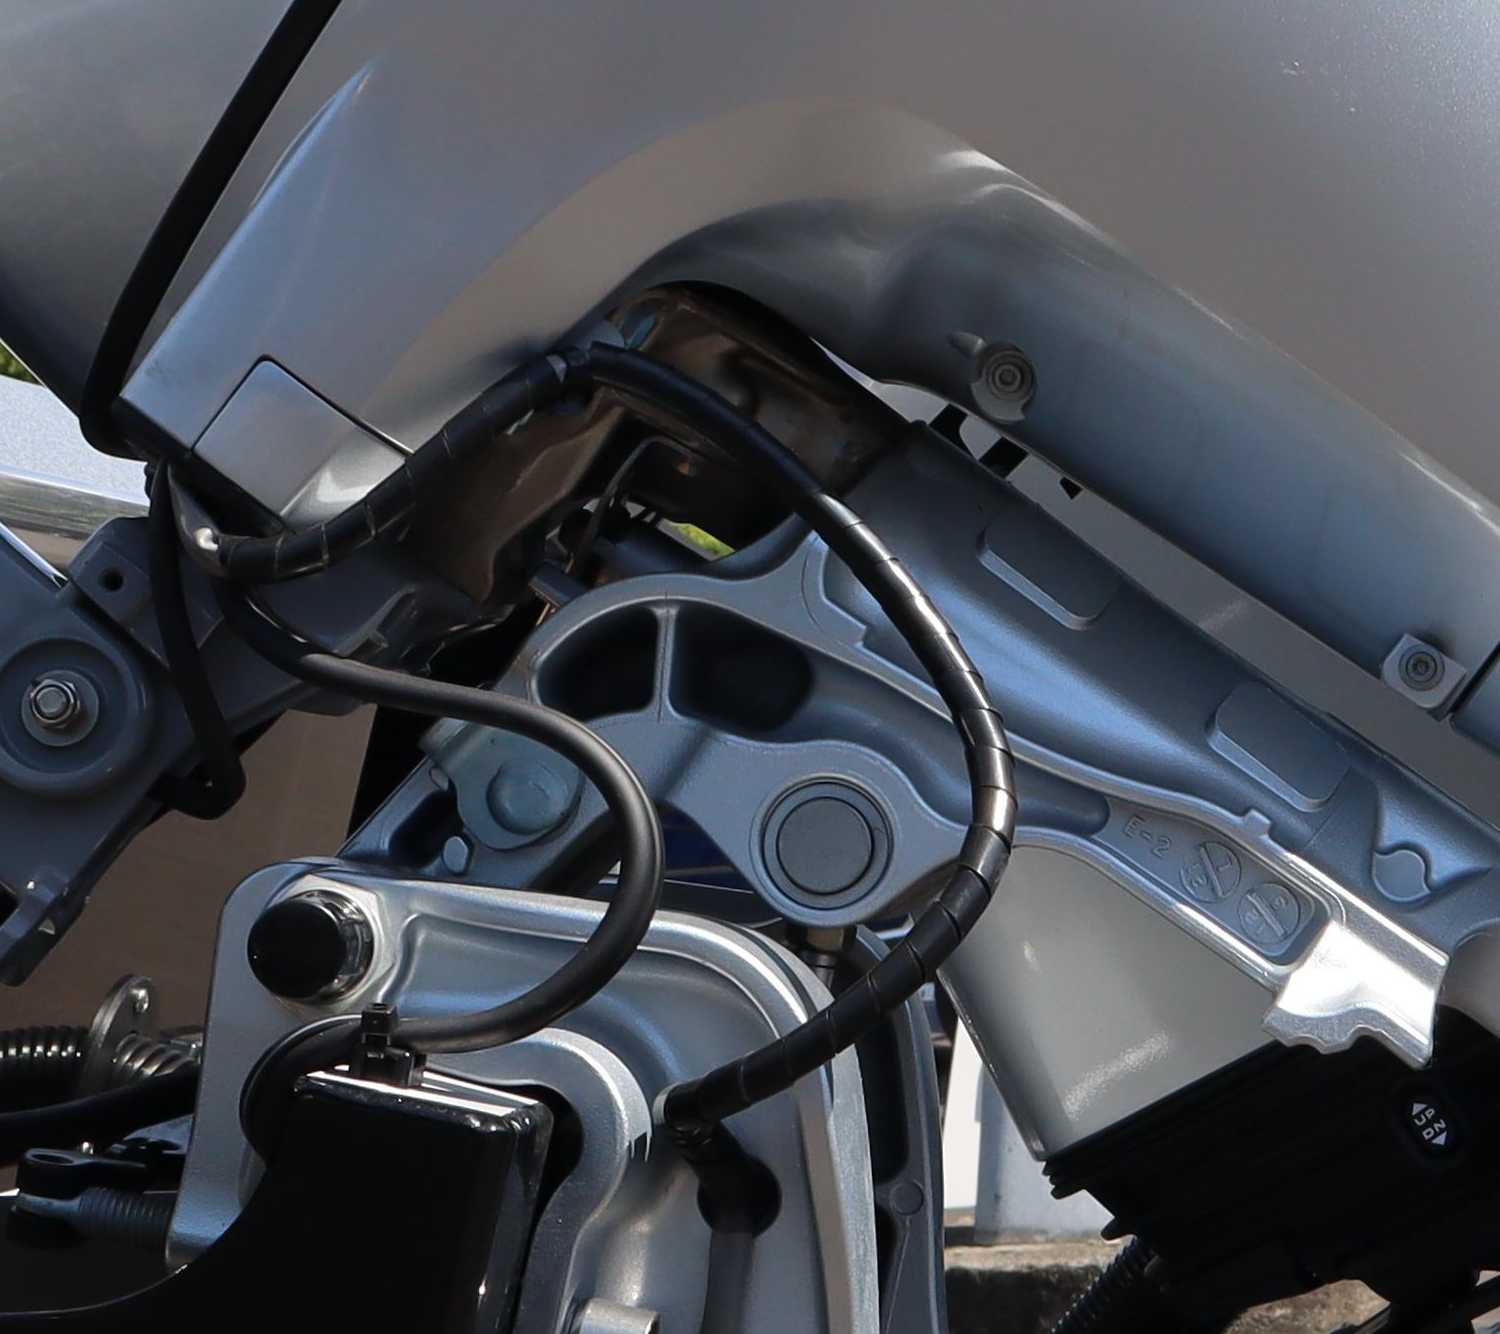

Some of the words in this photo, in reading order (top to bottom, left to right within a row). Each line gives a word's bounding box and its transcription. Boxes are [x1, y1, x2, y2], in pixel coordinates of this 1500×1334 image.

[1122, 814, 1173, 860] E-2
[1414, 1108, 1435, 1126] UP
[1422, 1118, 1446, 1140] DN
